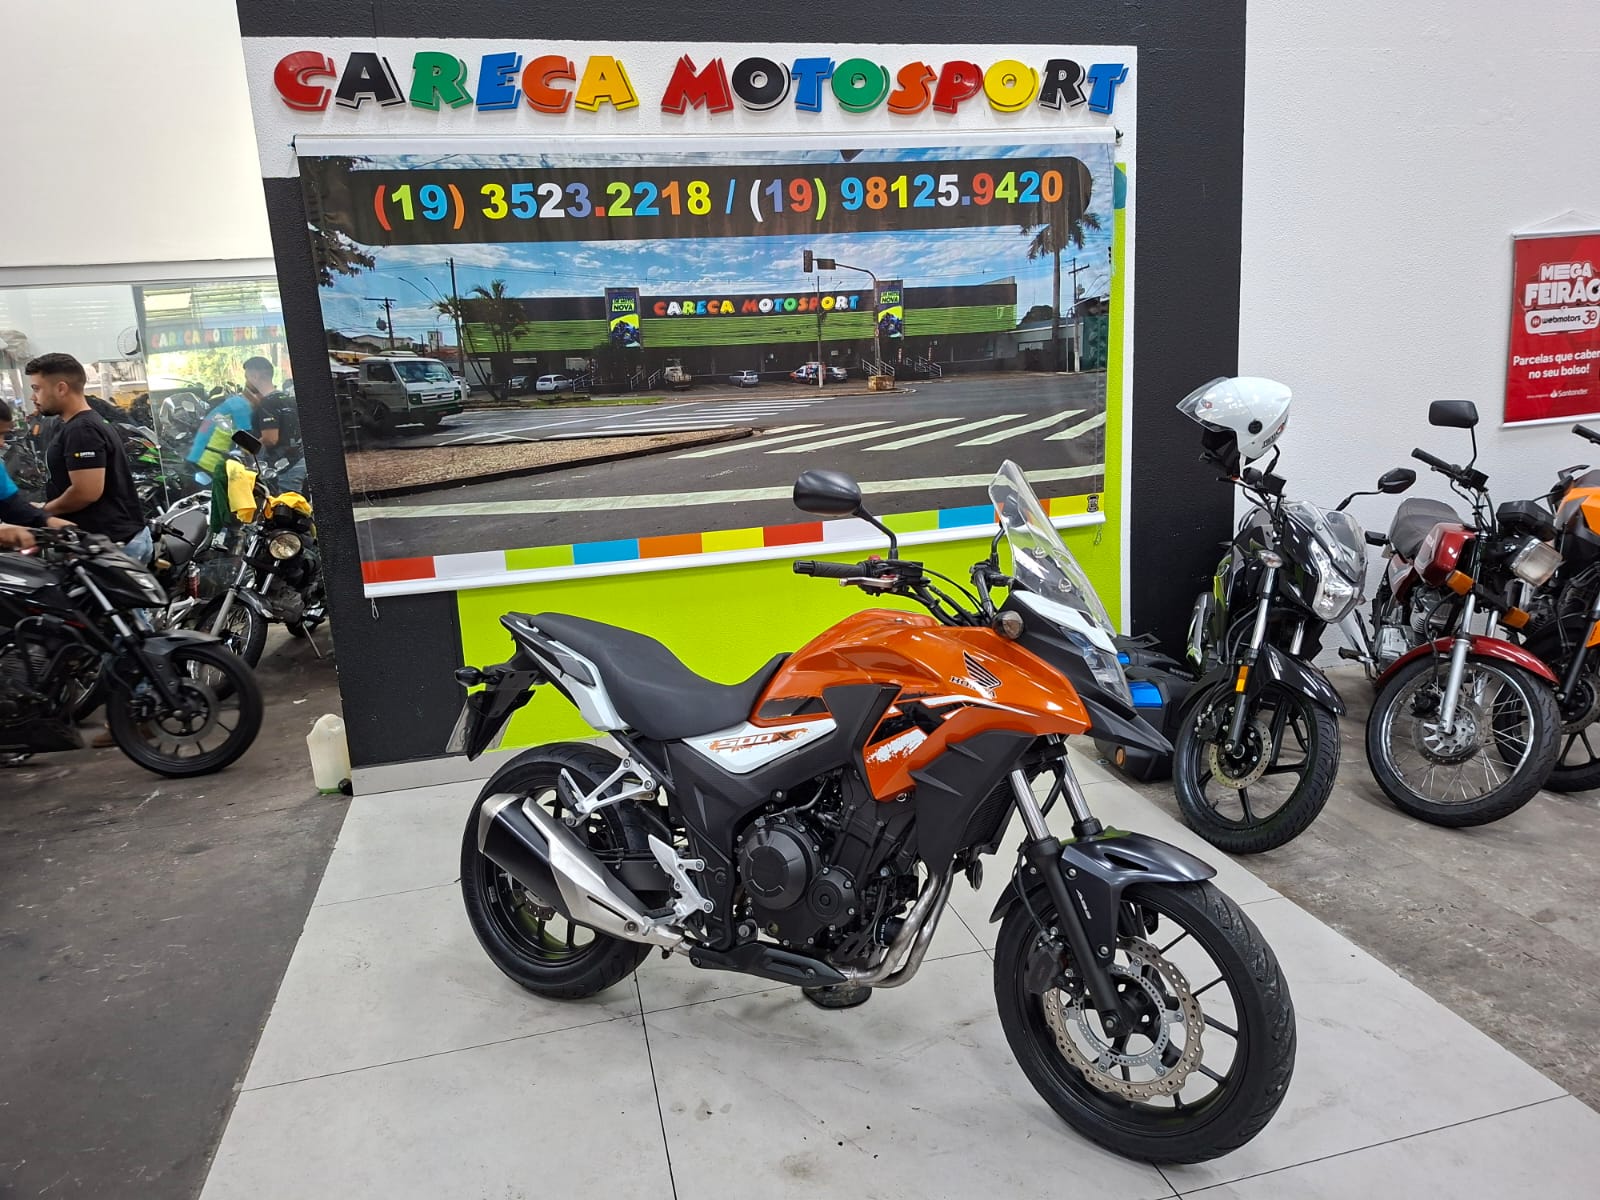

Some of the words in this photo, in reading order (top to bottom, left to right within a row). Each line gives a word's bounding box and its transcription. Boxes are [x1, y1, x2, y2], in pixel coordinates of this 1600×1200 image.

[273, 50, 639, 112] CARECA
[661, 53, 1128, 115] MOTOSPORT
[374, 183, 465, 231] (19)
[480, 179, 711, 220] 3523.2218
[750, 177, 827, 223] (19)
[840, 170, 1064, 211] 98125.9420
[1541, 262, 1592, 281] MEGA
[1525, 277, 1600, 307] FEIRÃO
[653, 300, 736, 316] CARECA
[741, 295, 860, 313] MOTOSPORT
[1542, 314, 1581, 324] webmotors
[1513, 353, 1554, 367] Parcelas
[1554, 352, 1574, 365] que
[1528, 370, 1542, 380] no
[1542, 367, 1560, 378] seu
[1560, 363, 1590, 376] bolso!
